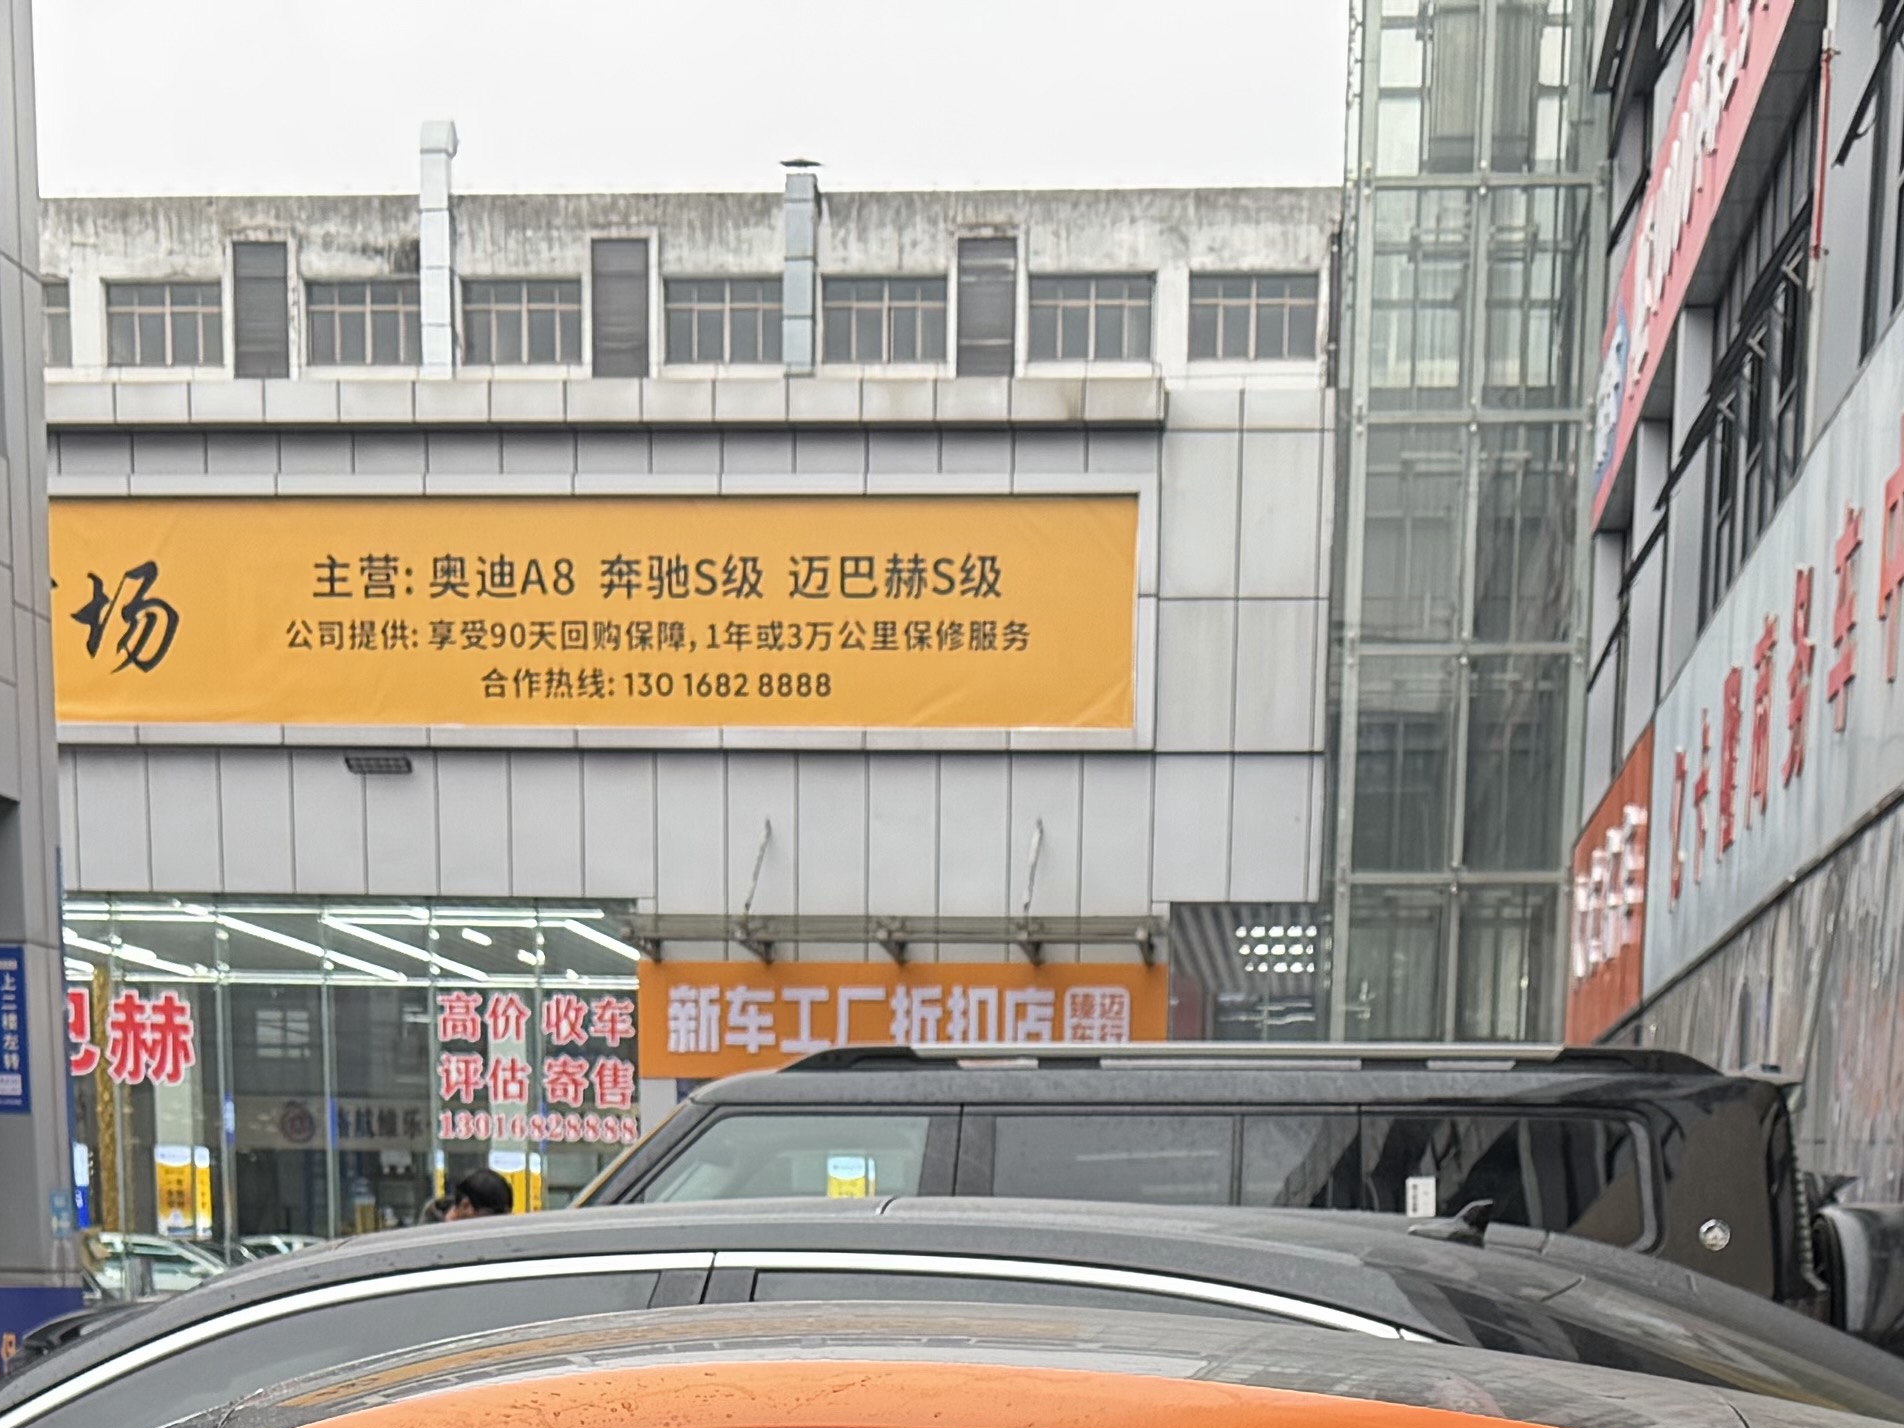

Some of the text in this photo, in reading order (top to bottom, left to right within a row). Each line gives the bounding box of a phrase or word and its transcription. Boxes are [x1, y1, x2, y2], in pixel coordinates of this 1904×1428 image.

[600, 553, 764, 599] 奔驰S级
[789, 553, 1002, 599] 迈巴赫S级
[437, 991, 636, 1047] 高价 收车
[667, 984, 1056, 1054] 新车工厂折扣店
[438, 1052, 636, 1110] 评估 寄售
[437, 1109, 638, 1145] 13016828888
